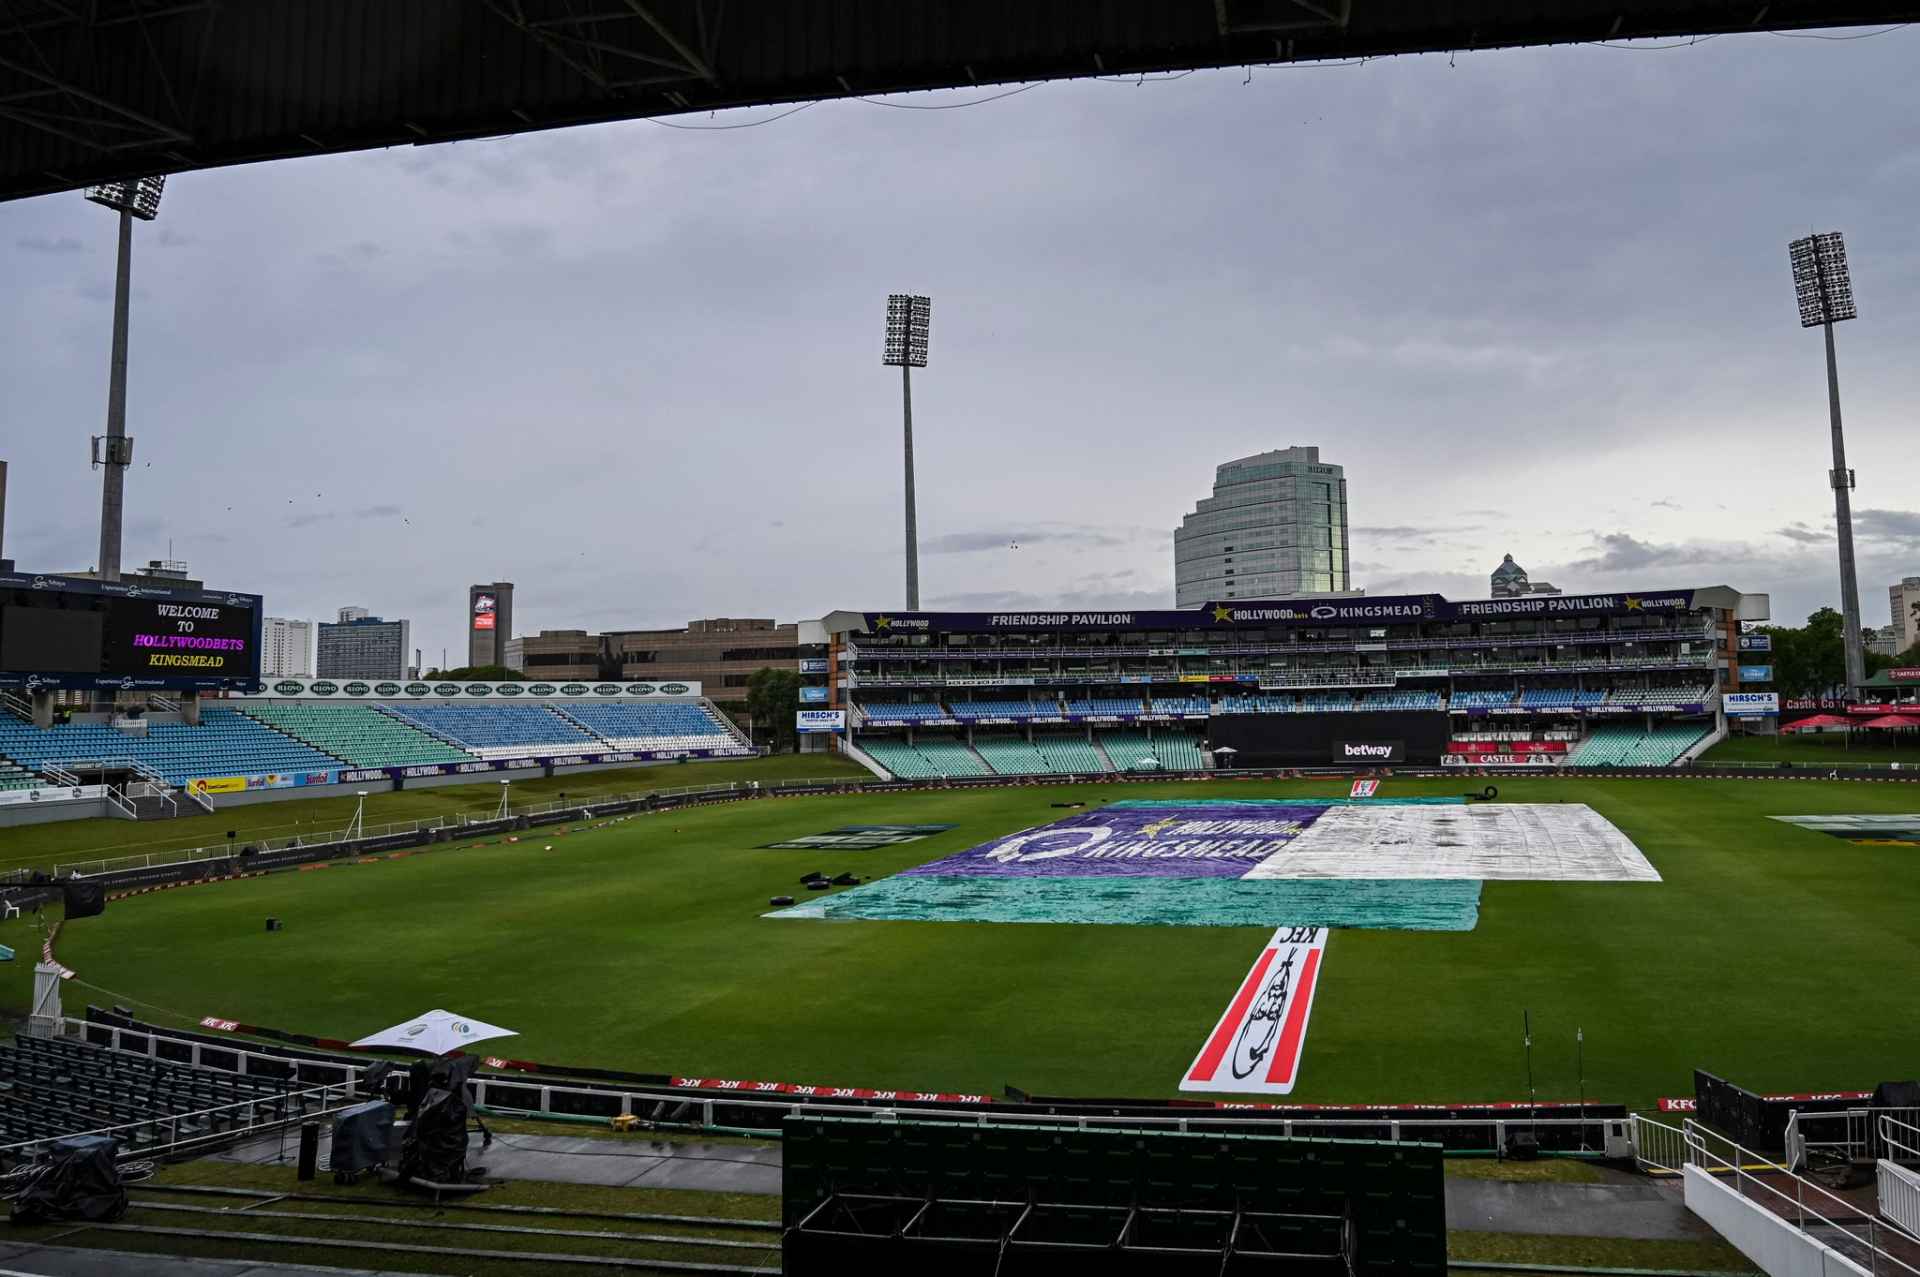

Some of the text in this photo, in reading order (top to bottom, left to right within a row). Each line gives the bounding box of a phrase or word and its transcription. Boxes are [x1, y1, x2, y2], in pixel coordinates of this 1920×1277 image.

[157, 604, 220, 619] WELCOME
[1340, 605, 1422, 618] KINGSMEAD
[1462, 597, 1614, 615] FRIENDSHIP PAVILION
[991, 614, 1131, 626] FRIENDSHIP PAVILION
[177, 621, 195, 632] TO
[133, 634, 245, 650] HOLLYWOODBETS
[149, 654, 224, 667] KINGSMEAD
[801, 711, 839, 719] HIRSCH'S
[1344, 744, 1392, 757] betway
[1480, 754, 1515, 763] CASTLE
[1280, 927, 1320, 943] KFC
[678, 1078, 701, 1088] KFC
[718, 1080, 740, 1089] KFC
[755, 1082, 778, 1091] KFC
[794, 1085, 816, 1096] KFC
[832, 1088, 855, 1097] KFC
[872, 1090, 896, 1099] KFC
[915, 1093, 938, 1101] KFC
[958, 1095, 982, 1103] KFC
[1667, 1099, 1697, 1110] KFC
